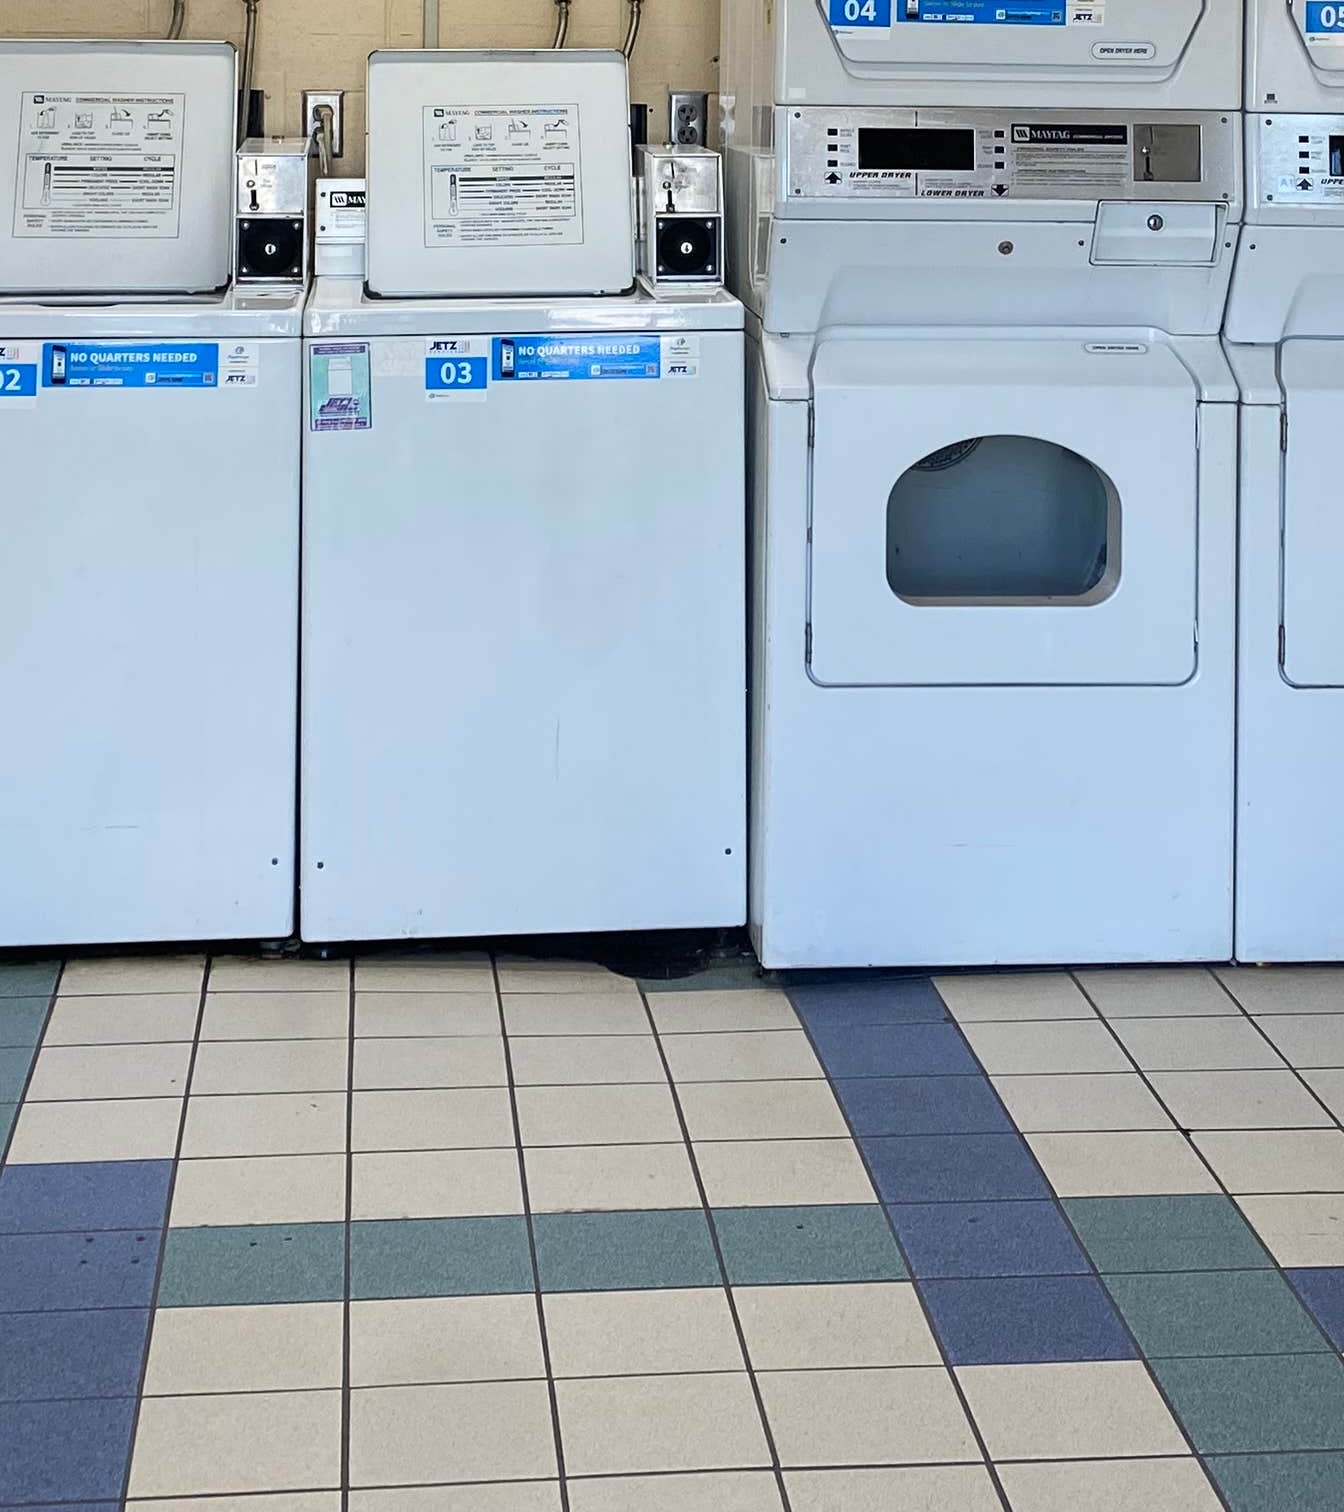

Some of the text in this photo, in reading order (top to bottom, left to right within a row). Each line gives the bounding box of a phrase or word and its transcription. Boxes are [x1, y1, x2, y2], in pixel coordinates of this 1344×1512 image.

[1072, 13, 1094, 23] JETZ
[1031, 130, 1071, 139] MAYTAG
[429, 341, 457, 351] JETZ
[518, 344, 641, 357] NO QUARTERS NEEDED
[70, 351, 197, 364] NO QUARTERS NEEDED
[440, 361, 473, 385] 03
